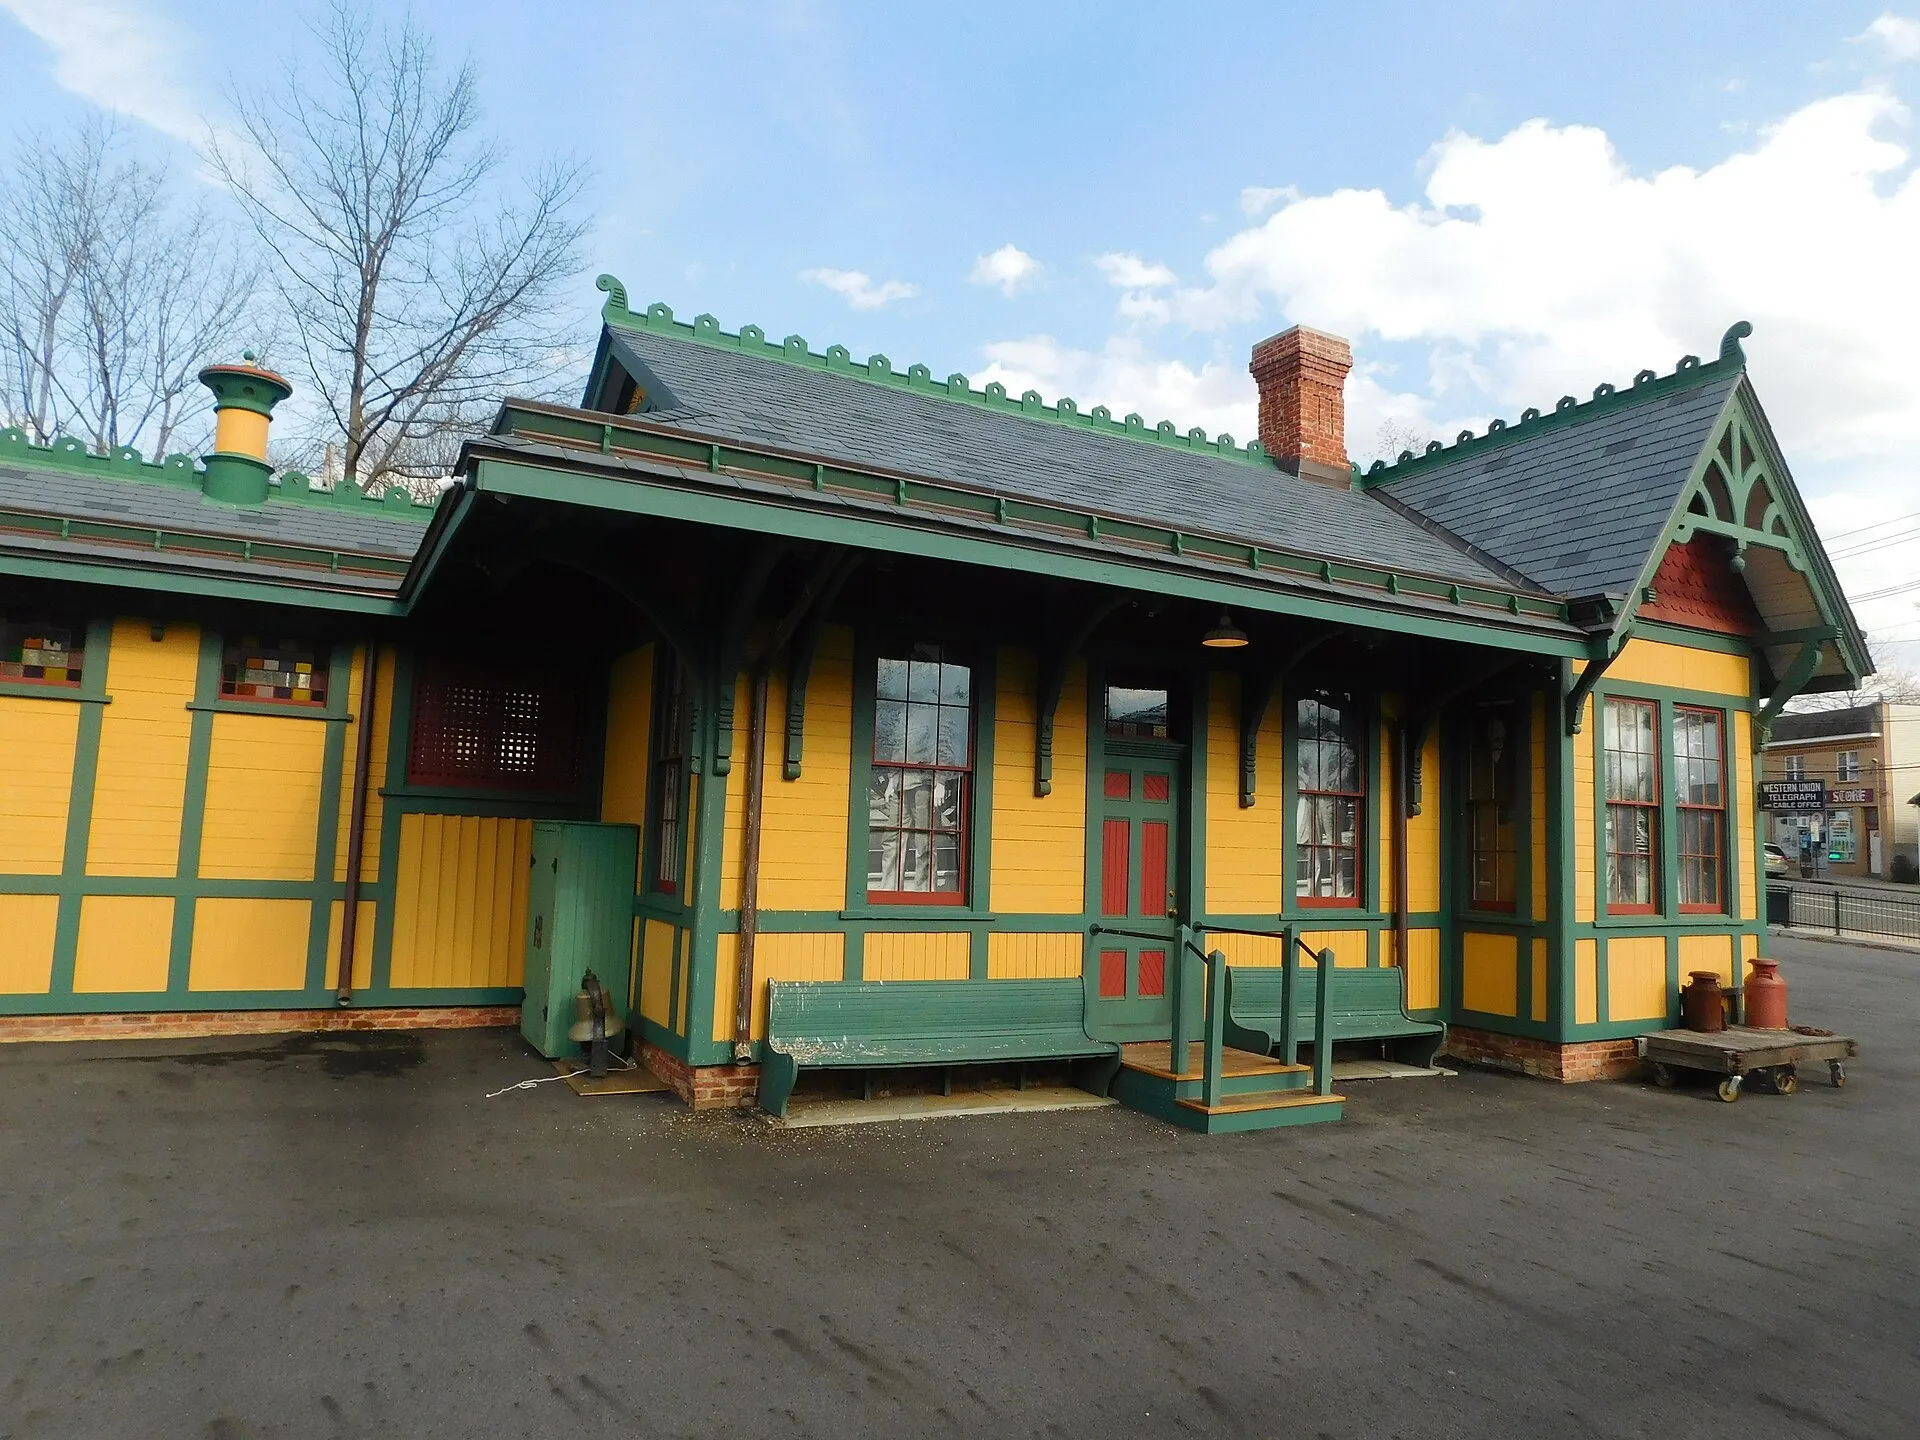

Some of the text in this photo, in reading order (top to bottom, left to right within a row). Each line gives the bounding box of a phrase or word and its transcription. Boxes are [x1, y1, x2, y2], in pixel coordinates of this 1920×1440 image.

[1763, 783, 1821, 793] WESTERN UNION
[1768, 793, 1816, 801] TELEGRAPH
[1832, 790, 1866, 802] STORE
